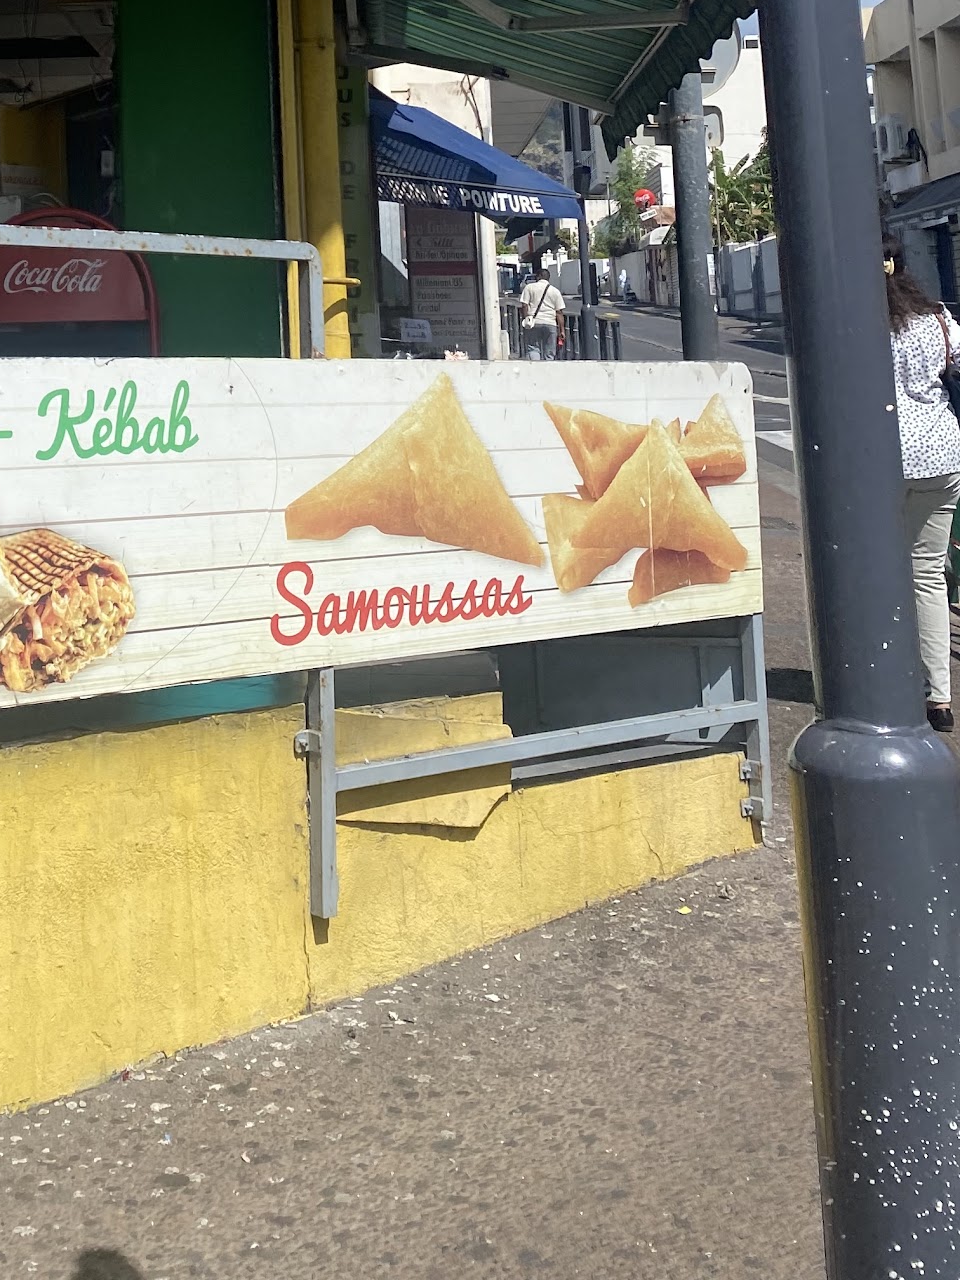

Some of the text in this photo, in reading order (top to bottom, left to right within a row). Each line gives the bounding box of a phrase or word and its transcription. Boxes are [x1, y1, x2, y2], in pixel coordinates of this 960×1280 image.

[342, 160, 356, 200] DE
[459, 187, 545, 214] POINTURE
[3, 258, 110, 294] Coca-Cola
[36, 380, 200, 461] Kébab
[270, 561, 533, 646] Samoussas
